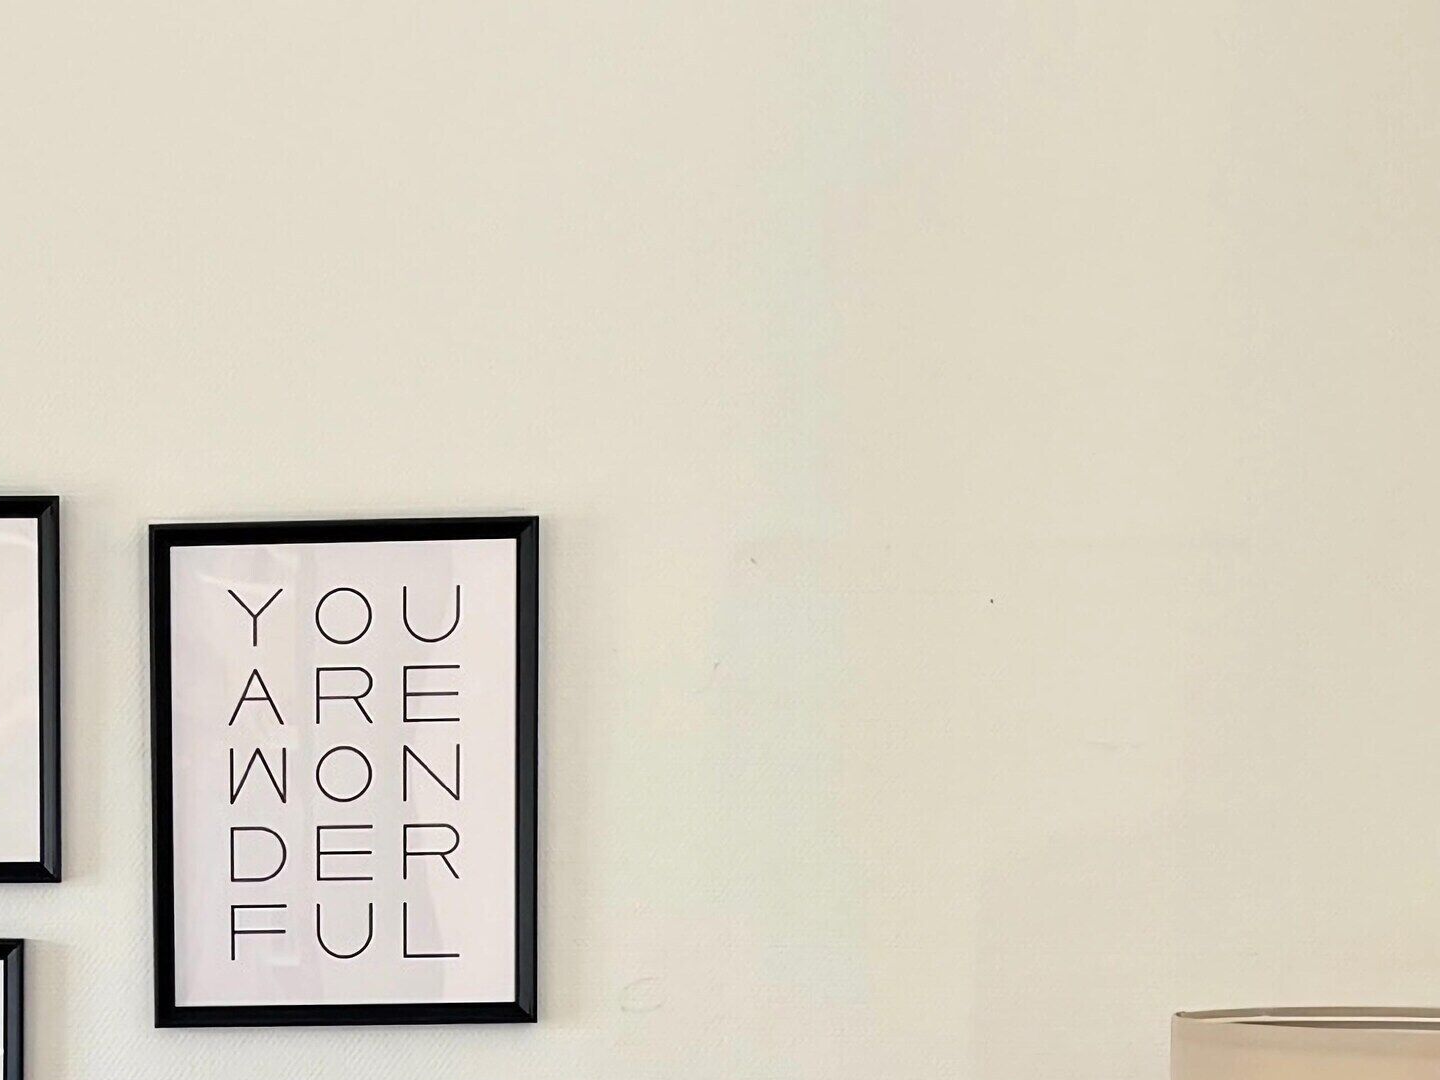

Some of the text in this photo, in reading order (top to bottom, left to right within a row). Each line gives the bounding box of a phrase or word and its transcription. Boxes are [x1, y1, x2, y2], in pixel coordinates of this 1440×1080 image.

[227, 584, 462, 647] YOU
[228, 664, 462, 727] ARE
[229, 742, 461, 805] WON
[230, 822, 461, 883] DER
[230, 901, 462, 961] FUL
